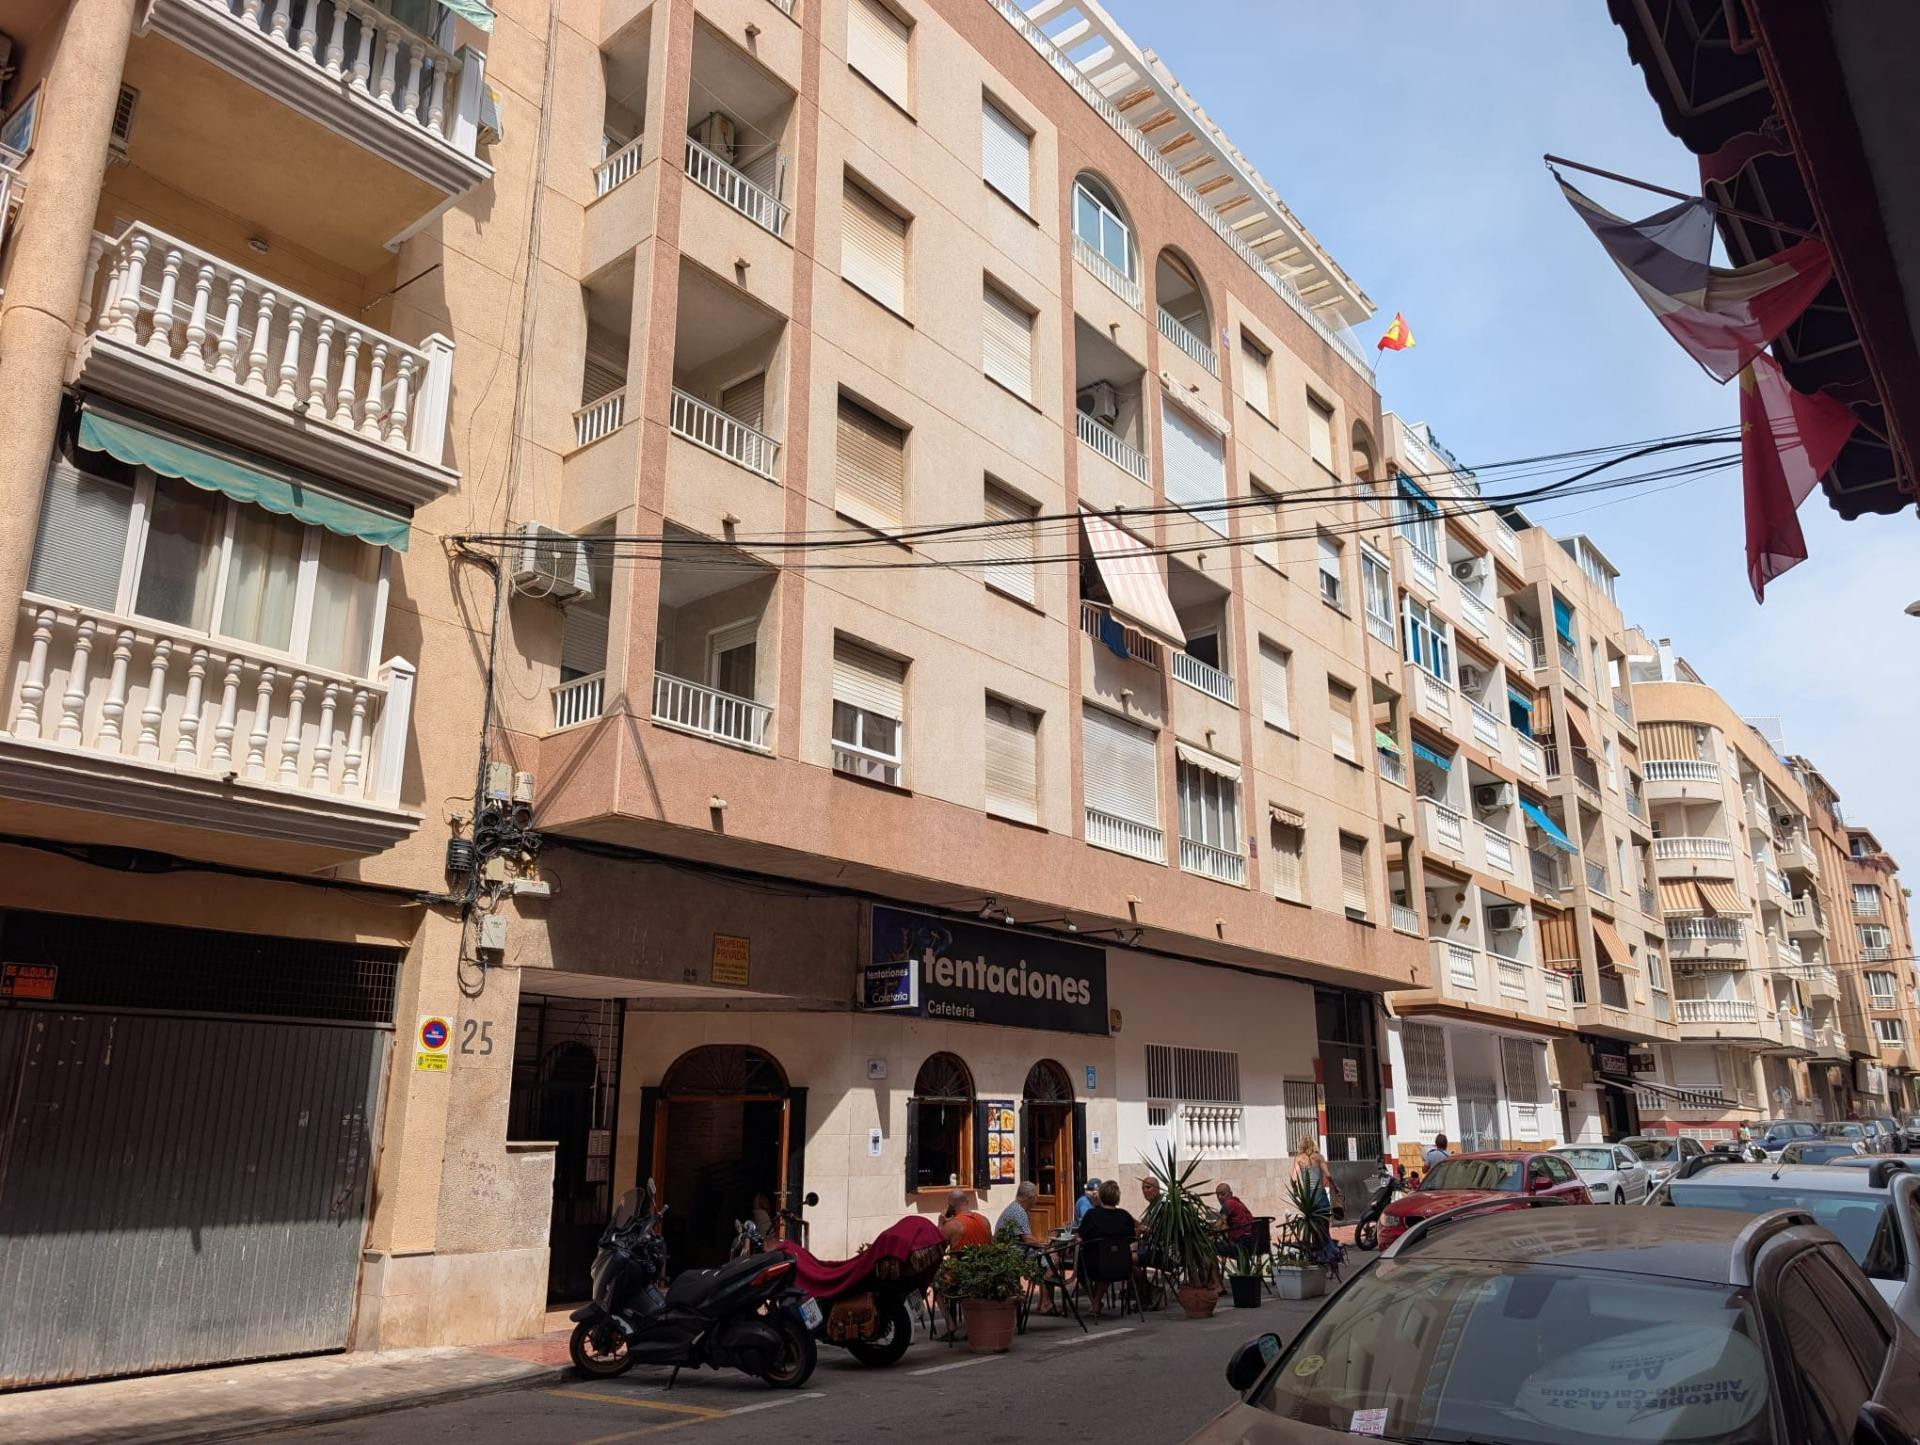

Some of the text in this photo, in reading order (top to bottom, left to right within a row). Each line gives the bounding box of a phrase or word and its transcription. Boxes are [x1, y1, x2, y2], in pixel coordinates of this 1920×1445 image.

[18, 966, 55, 978] ALQUILA
[867, 966, 909, 979] tentaciones
[923, 948, 1091, 1005] tentaciones
[460, 1019, 493, 1055] 25
